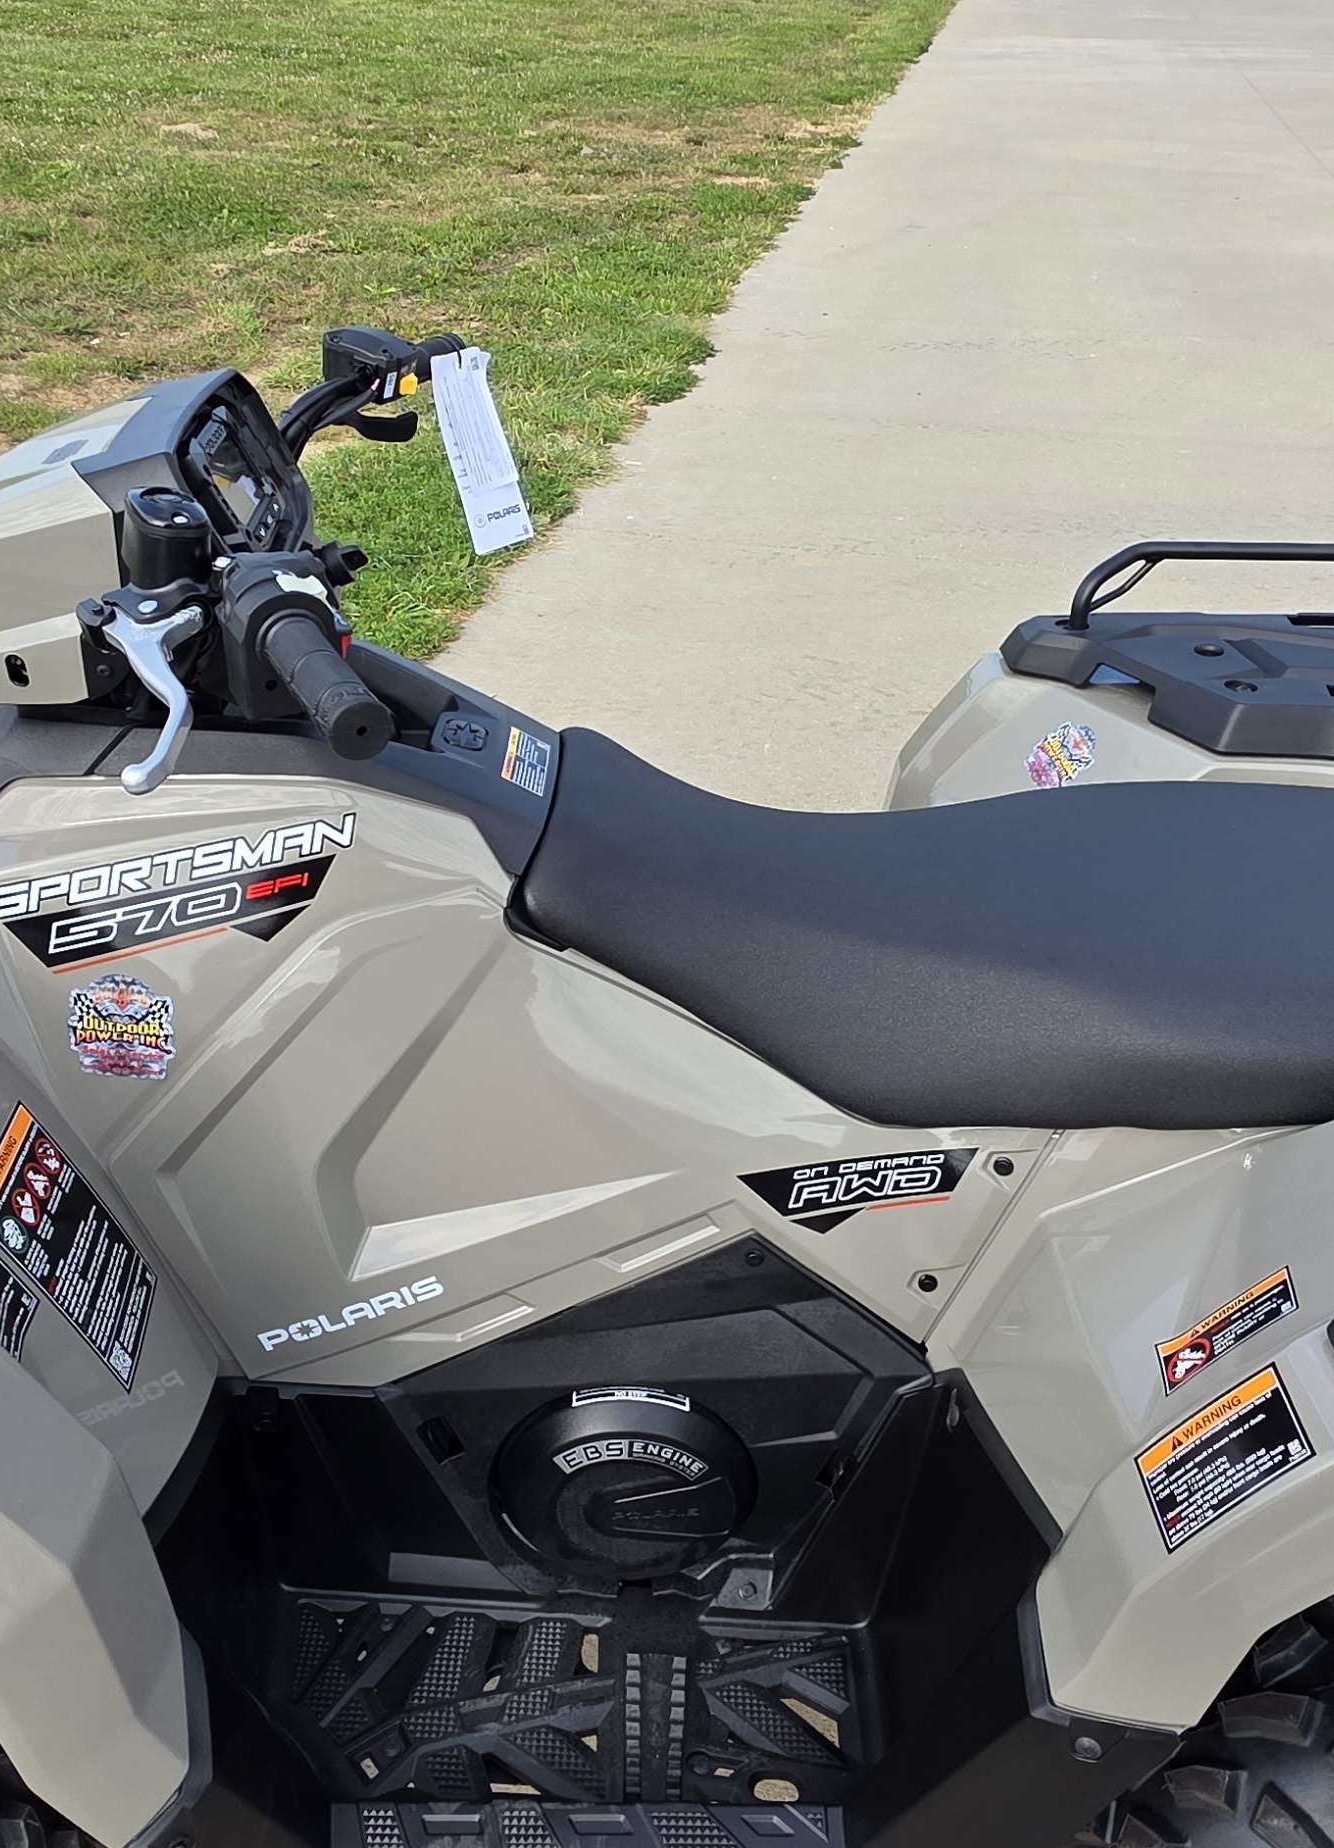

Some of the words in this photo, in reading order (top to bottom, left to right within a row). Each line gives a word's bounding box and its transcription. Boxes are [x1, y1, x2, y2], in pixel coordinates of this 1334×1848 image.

[48, 882, 241, 954] 570
[246, 872, 308, 900] EFI
[76, 1029, 134, 1044] POWER
[83, 1015, 160, 1036] OUTDOOR
[793, 1166, 829, 1179] ON
[839, 1154, 944, 1173] DEMAND
[788, 1166, 942, 1208] AWD
[257, 1276, 444, 1351] POLARIS
[1202, 1291, 1254, 1329] WARNING
[1182, 1395, 1242, 1440] WARNING
[562, 1442, 624, 1469] EBS
[632, 1442, 703, 1473] ENGINE
